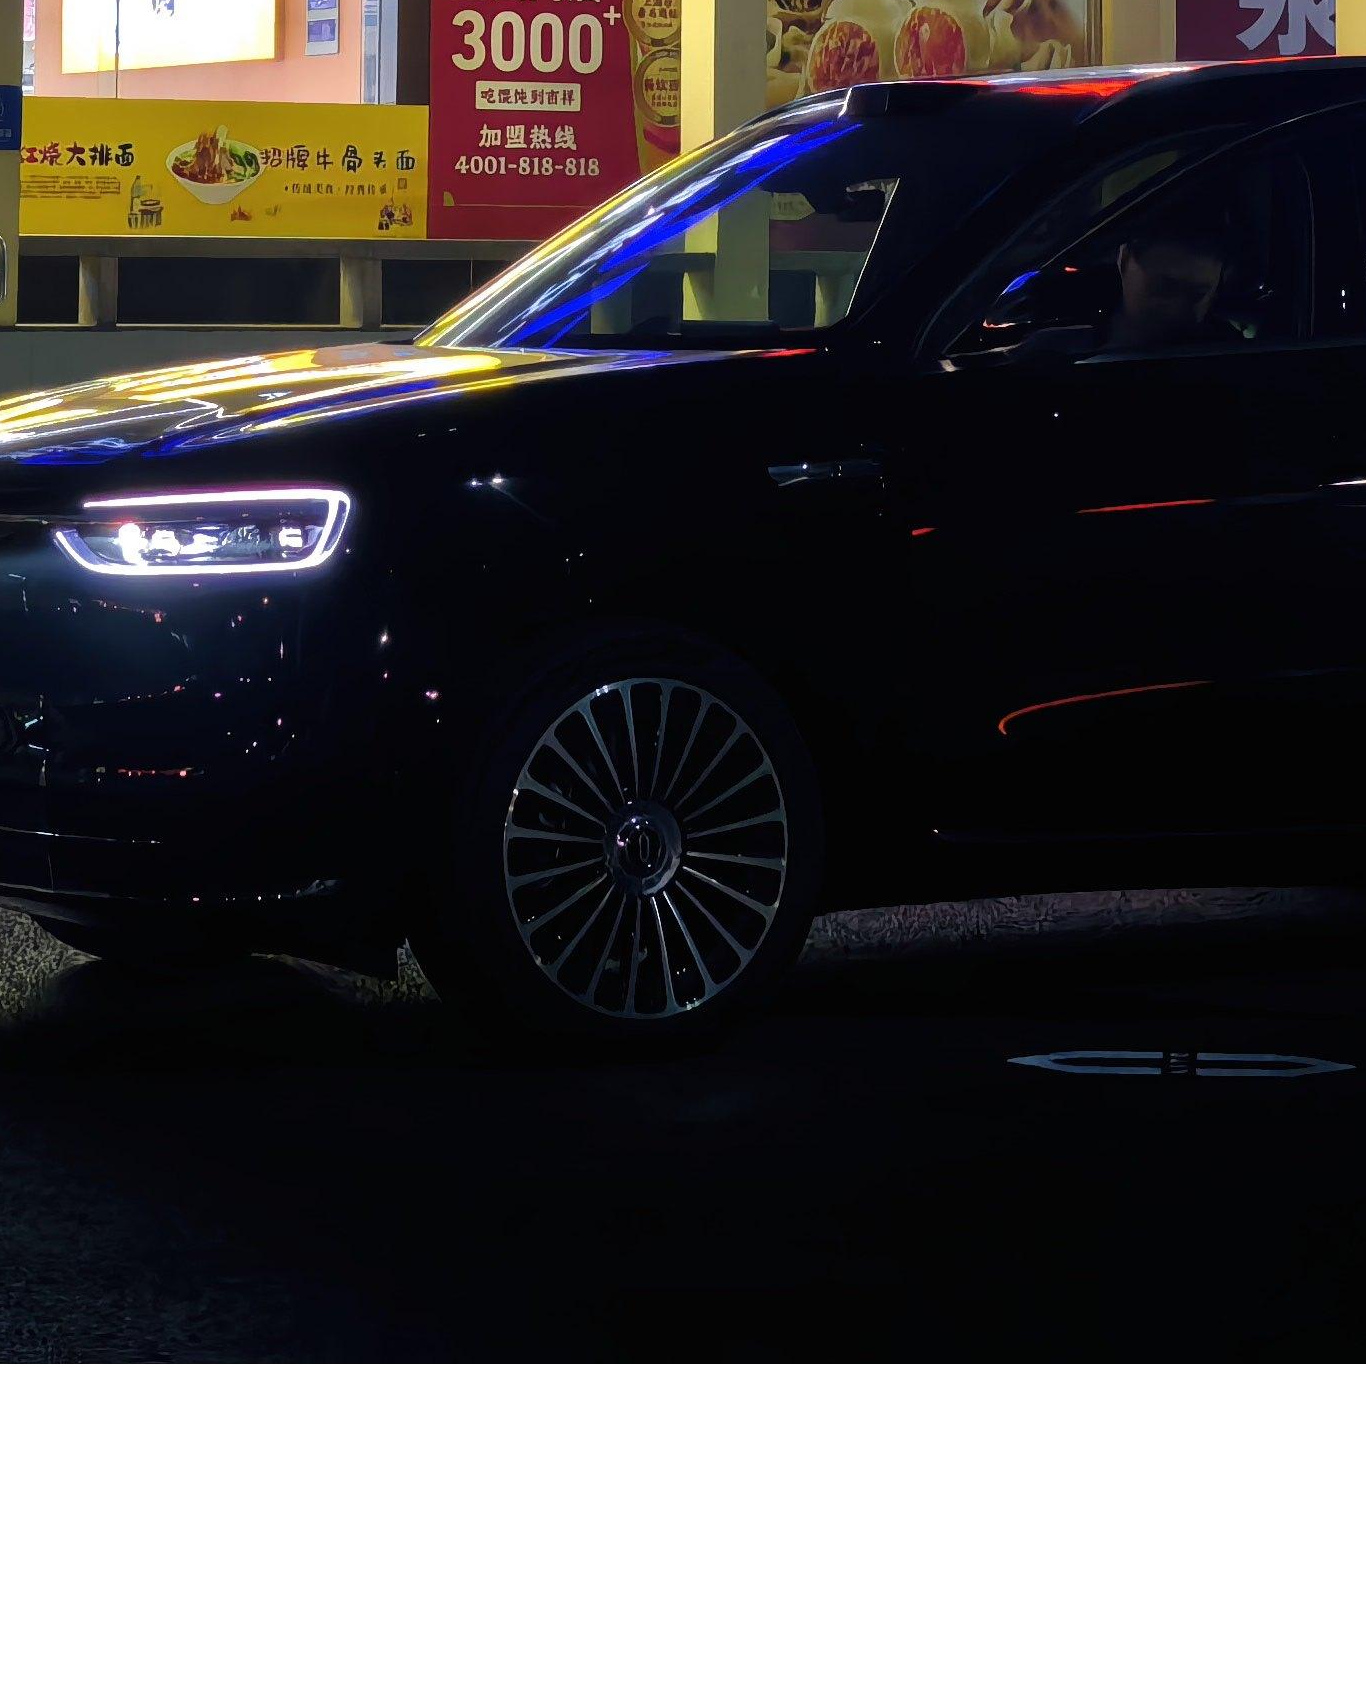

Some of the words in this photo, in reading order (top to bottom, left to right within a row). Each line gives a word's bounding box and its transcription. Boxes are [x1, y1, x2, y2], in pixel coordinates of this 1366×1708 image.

[478, 123, 578, 151] 加盟热线
[454, 155, 601, 177] 4001-818-818
